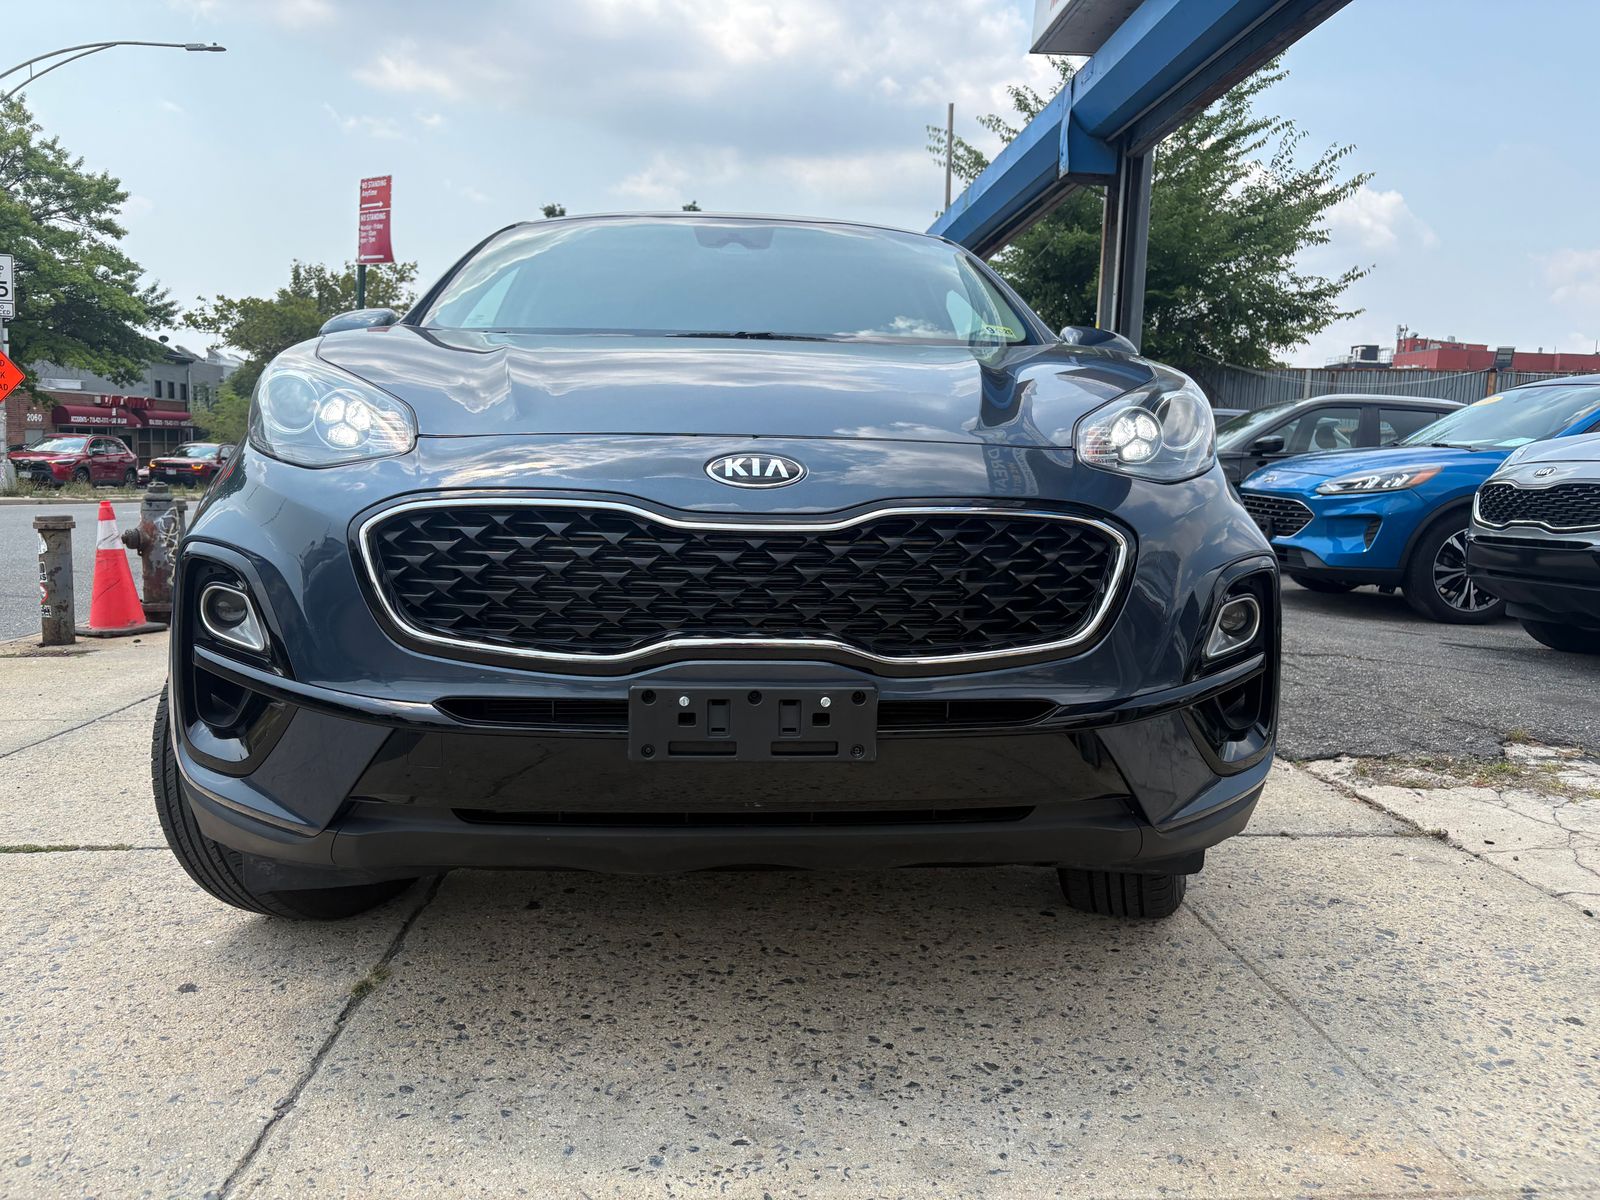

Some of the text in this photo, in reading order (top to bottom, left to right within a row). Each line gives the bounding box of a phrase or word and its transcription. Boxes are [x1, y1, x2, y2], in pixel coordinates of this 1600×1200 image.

[368, 179, 387, 187] STANDING
[367, 212, 386, 220] STANDING
[724, 457, 790, 479] KIA
